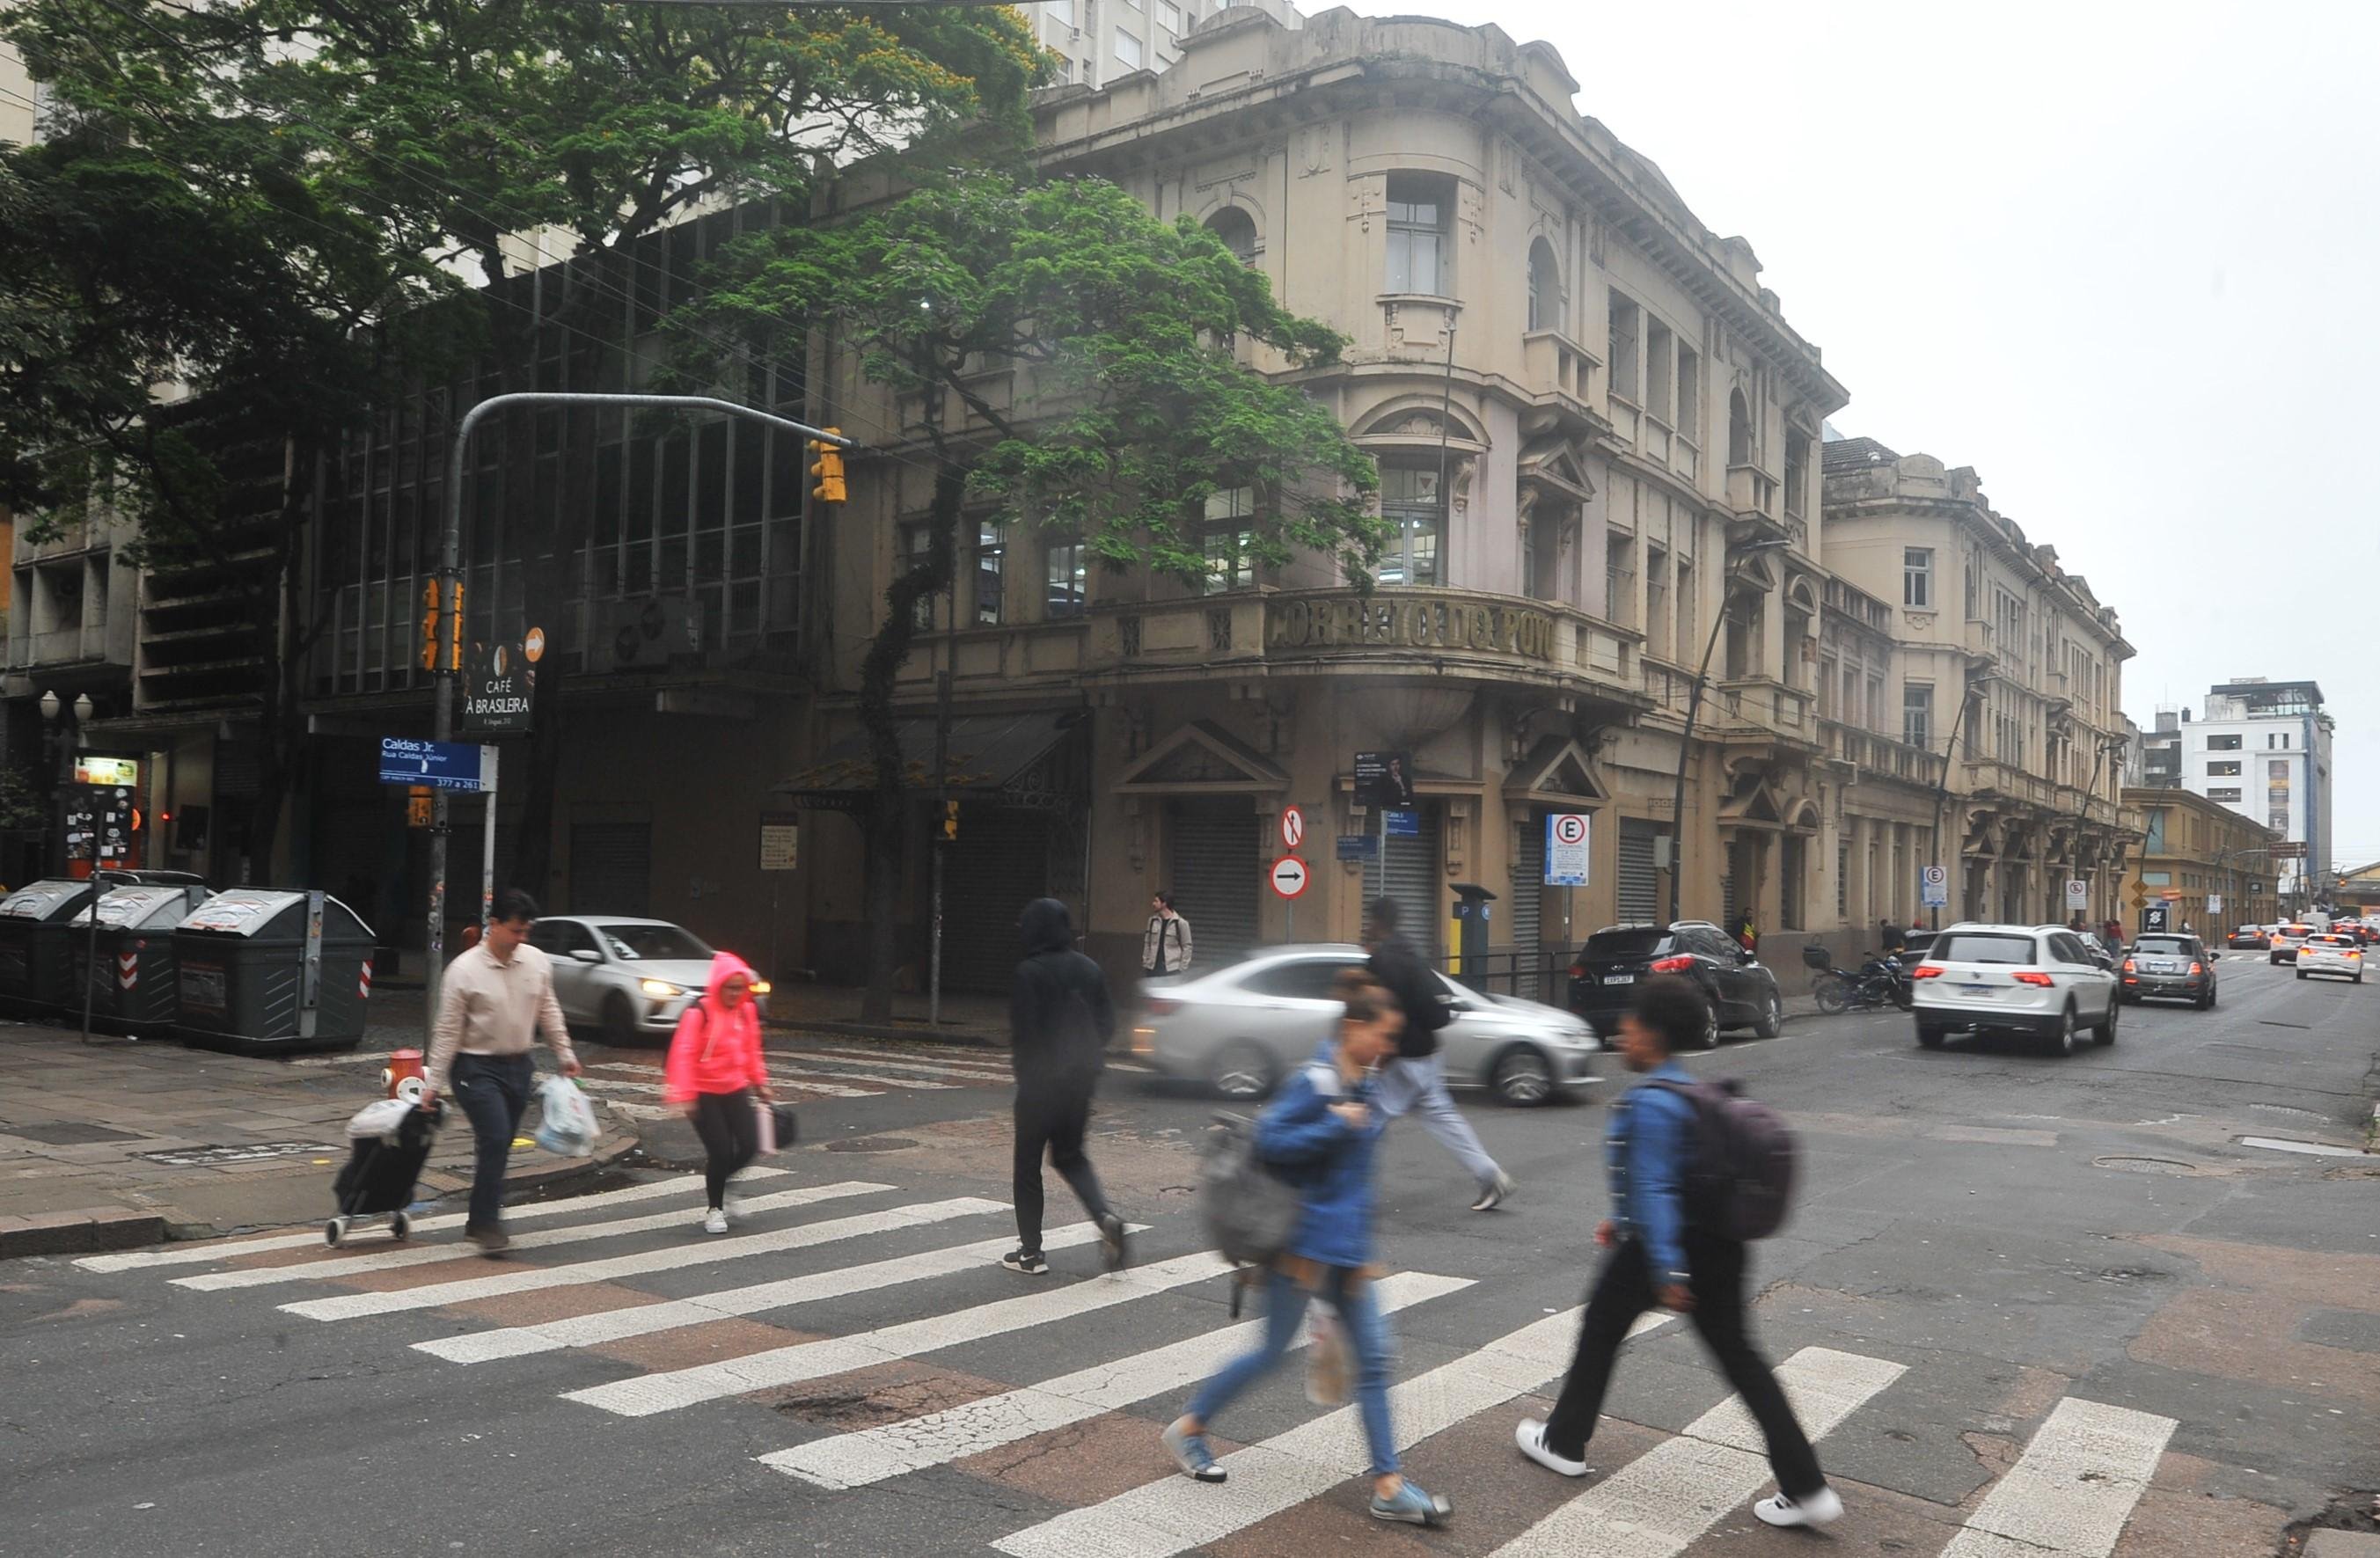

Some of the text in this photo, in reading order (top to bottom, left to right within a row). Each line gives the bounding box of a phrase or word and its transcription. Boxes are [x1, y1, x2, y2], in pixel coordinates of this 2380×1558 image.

[1265, 598, 1557, 660] CORREIO DO POVO
[486, 677, 512, 693] CAFÉ
[465, 695, 530, 714] À BRASILEIRA
[382, 738, 435, 752] Caldas Jr.
[463, 780, 479, 789] 261
[1565, 822, 1576, 838] E
[1931, 870, 1938, 880] E
[1461, 906, 1469, 916] P
